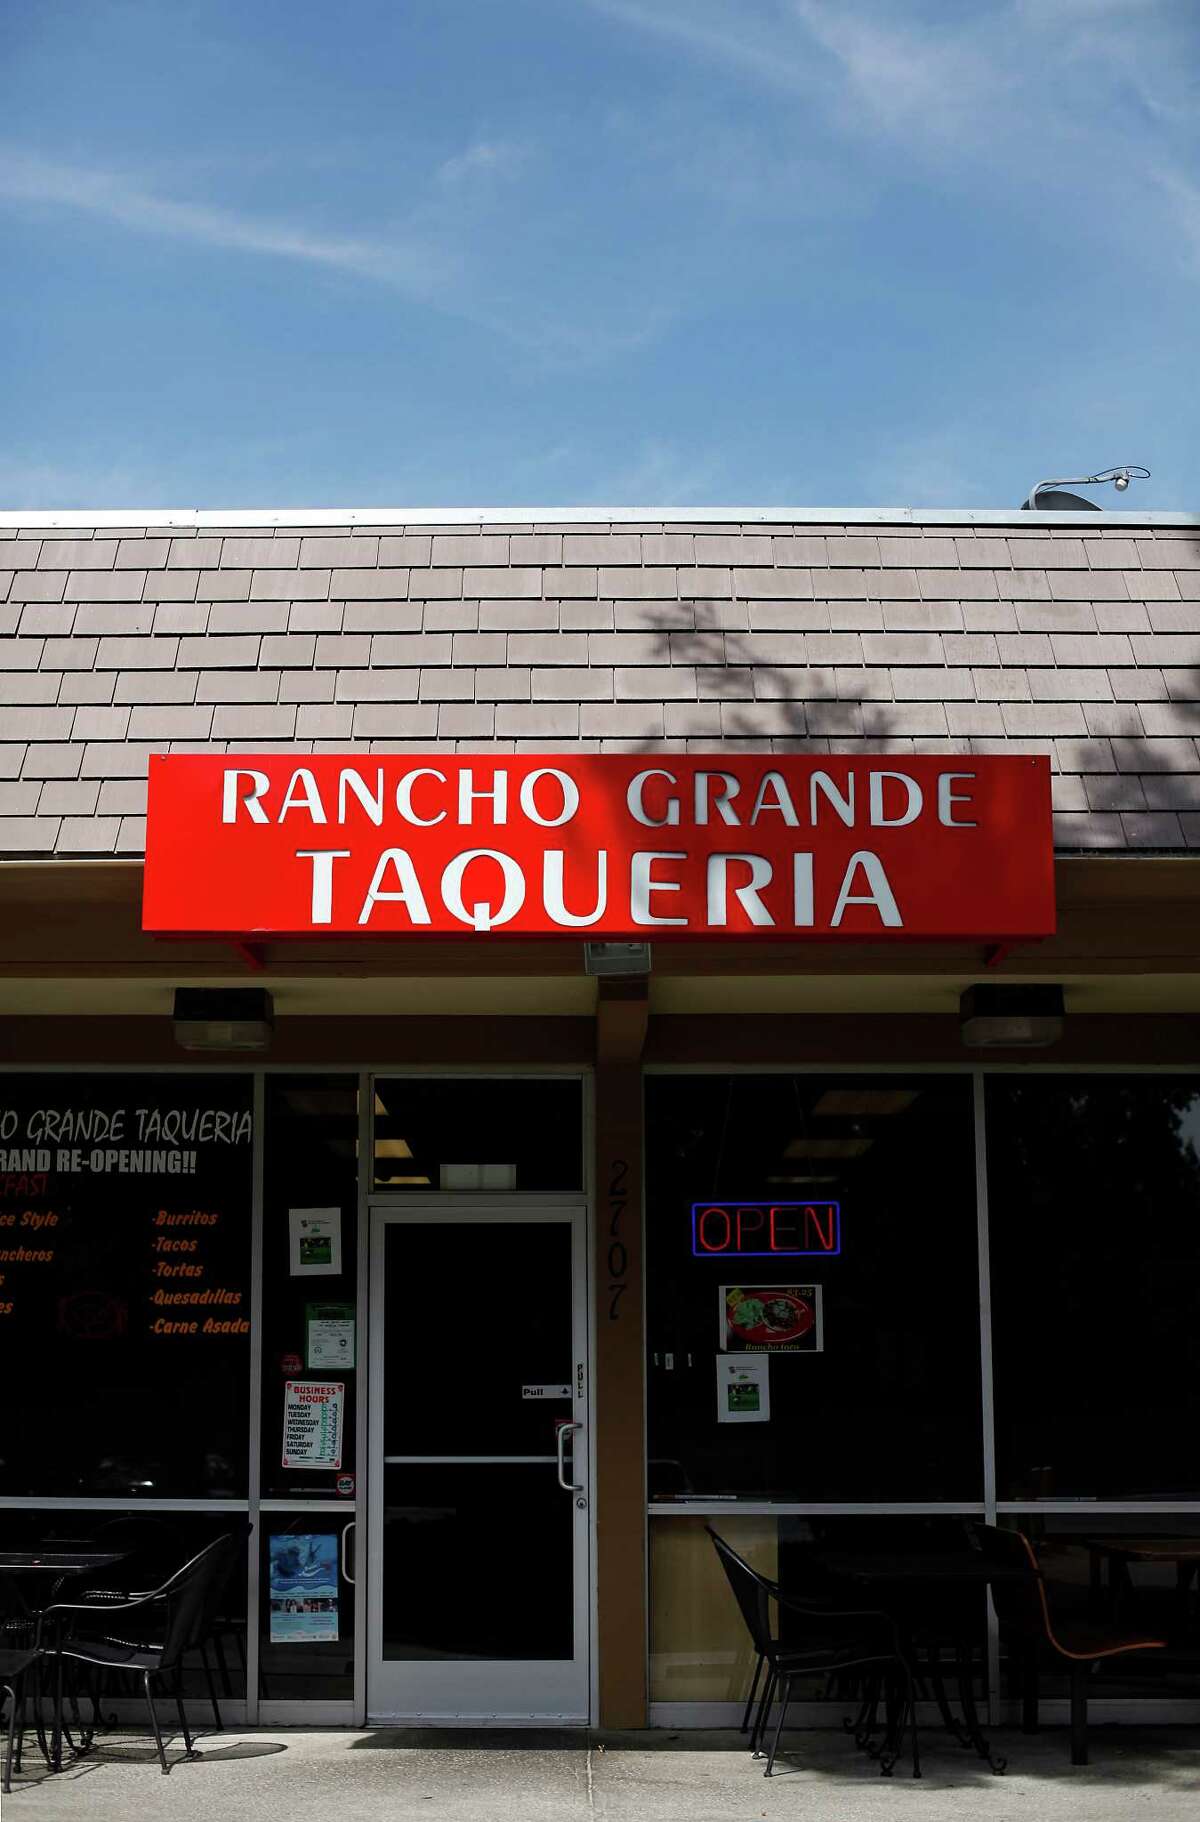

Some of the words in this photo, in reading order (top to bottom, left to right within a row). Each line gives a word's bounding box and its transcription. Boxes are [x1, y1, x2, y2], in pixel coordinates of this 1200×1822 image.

[222, 767, 580, 827] RANCHO
[626, 769, 977, 828] GRANDE
[295, 848, 904, 932] TAQUERIA
[27, 1109, 125, 1145] GRANDE
[135, 1109, 252, 1146] TAQUERIA
[56, 1149, 197, 1174] RE-OPENING!!
[20, 1210, 59, 1230] Style
[151, 1209, 219, 1226] -Burritos
[700, 1206, 833, 1251] OPEN
[151, 1236, 198, 1252] -Tacos
[608, 1159, 629, 1320] 2707
[152, 1261, 204, 1278] -Tortas
[149, 1288, 242, 1306] -Quesadillas
[149, 1318, 199, 1335] -Carne
[202, 1317, 250, 1334] Asada
[293, 1386, 336, 1395] BUSINESS
[299, 1395, 330, 1403] HOURS
[523, 1387, 544, 1397] Pull
